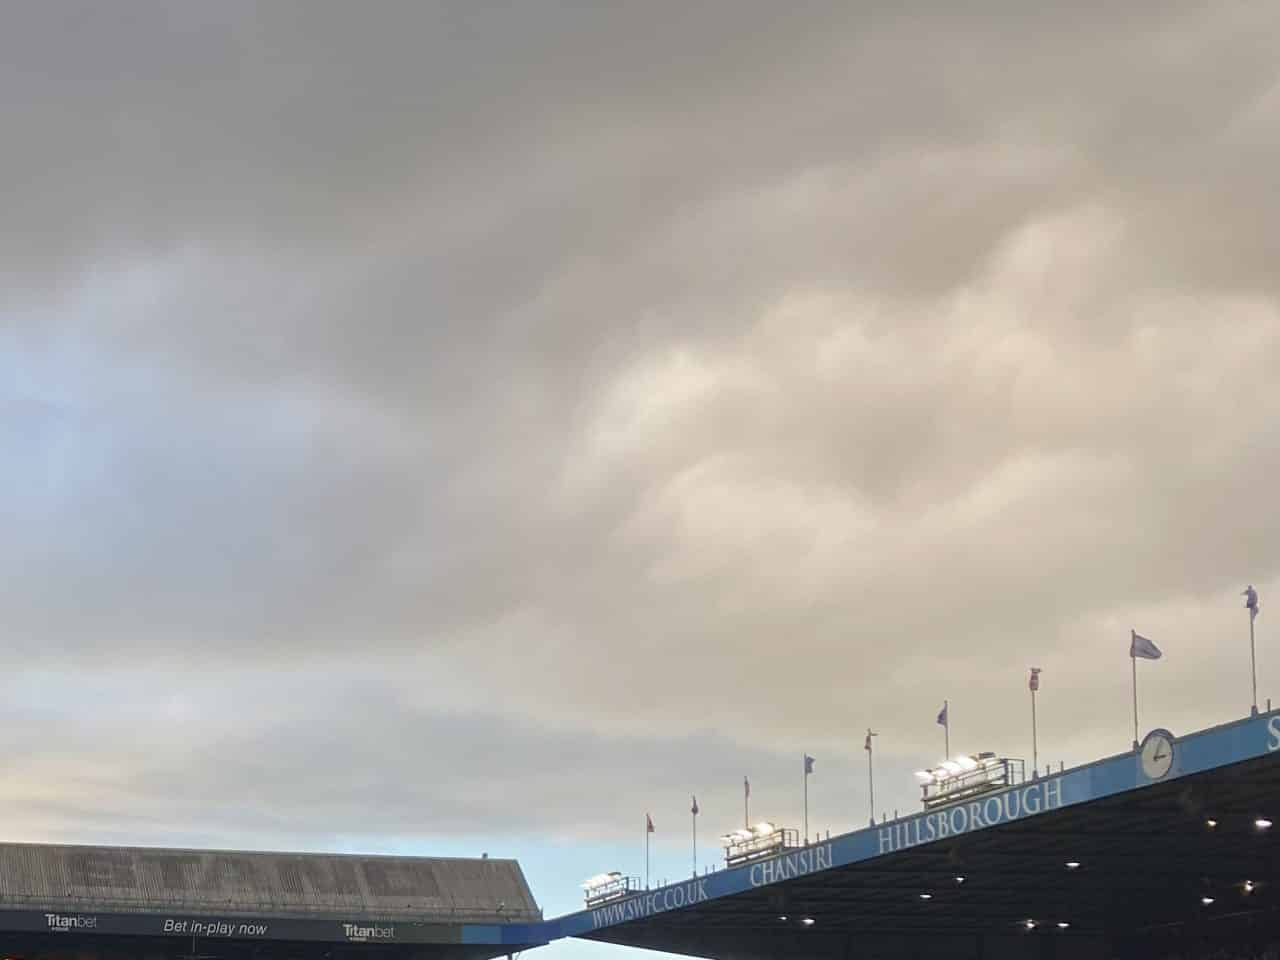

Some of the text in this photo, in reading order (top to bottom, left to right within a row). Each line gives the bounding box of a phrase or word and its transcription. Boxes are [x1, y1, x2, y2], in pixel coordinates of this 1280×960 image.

[878, 778, 1064, 855] HILLSBOROUGH
[749, 843, 833, 888] CHANSIRI
[592, 879, 709, 930] WWW.SWFC.CO.UK
[45, 913, 97, 929] Titanbet
[163, 919, 268, 937] Bet in-play now
[342, 923, 396, 939] Titanbet
